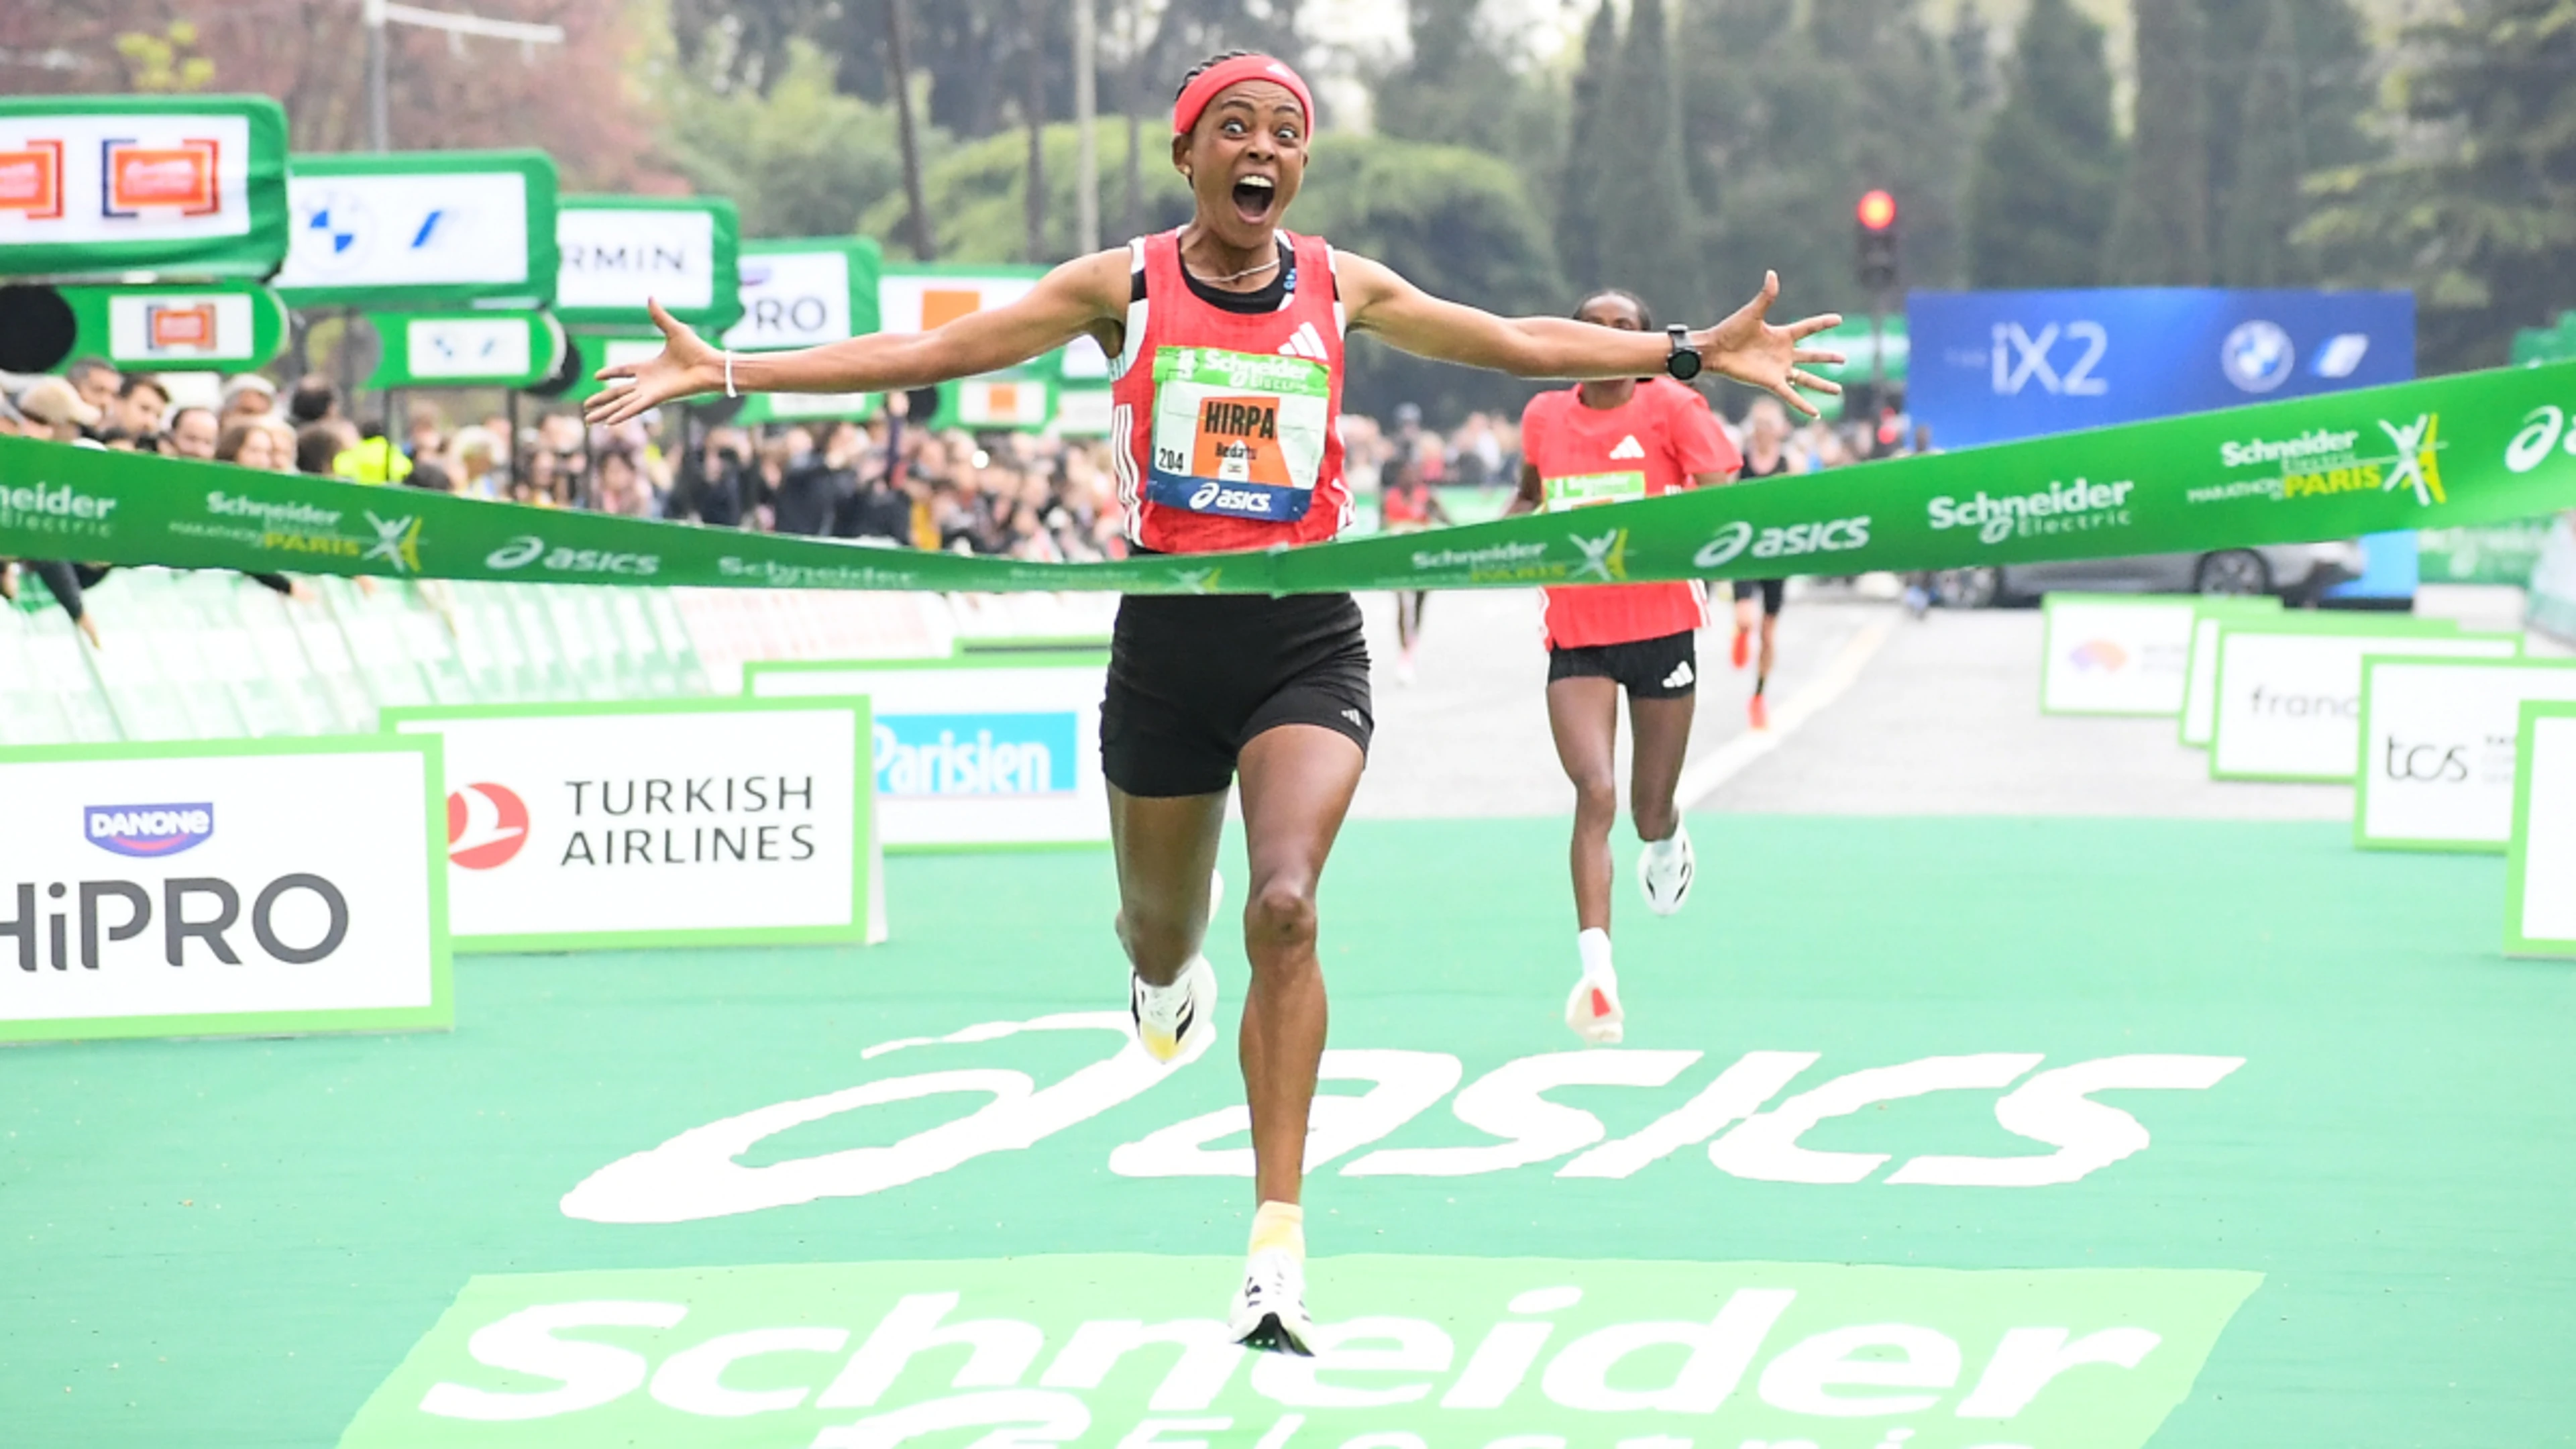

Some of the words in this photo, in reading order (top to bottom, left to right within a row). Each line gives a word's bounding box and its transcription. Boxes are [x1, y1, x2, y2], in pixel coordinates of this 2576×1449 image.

[1204, 350, 1312, 381] Schneider
[1991, 320, 2108, 396] iX2
[1205, 401, 1274, 440] HIRPA
[1159, 447, 1183, 472] 204
[2220, 428, 2359, 467] Schneider
[1215, 488, 1271, 512] asics
[2284, 463, 2382, 498] PARIS
[205, 490, 343, 526] Schneider
[1928, 477, 2134, 531] Schneider
[2017, 509, 2132, 537] Electric
[263, 532, 360, 557] PARIS
[1412, 540, 1548, 570] Schneider
[1750, 515, 1872, 558] asics
[544, 547, 660, 577] asics
[2385, 733, 2469, 783] tcs
[564, 775, 814, 816] TURKISH
[560, 824, 815, 865] AIRLINES
[1111, 1049, 2245, 1185] asics
[419, 1288, 2161, 1419] Schneider
